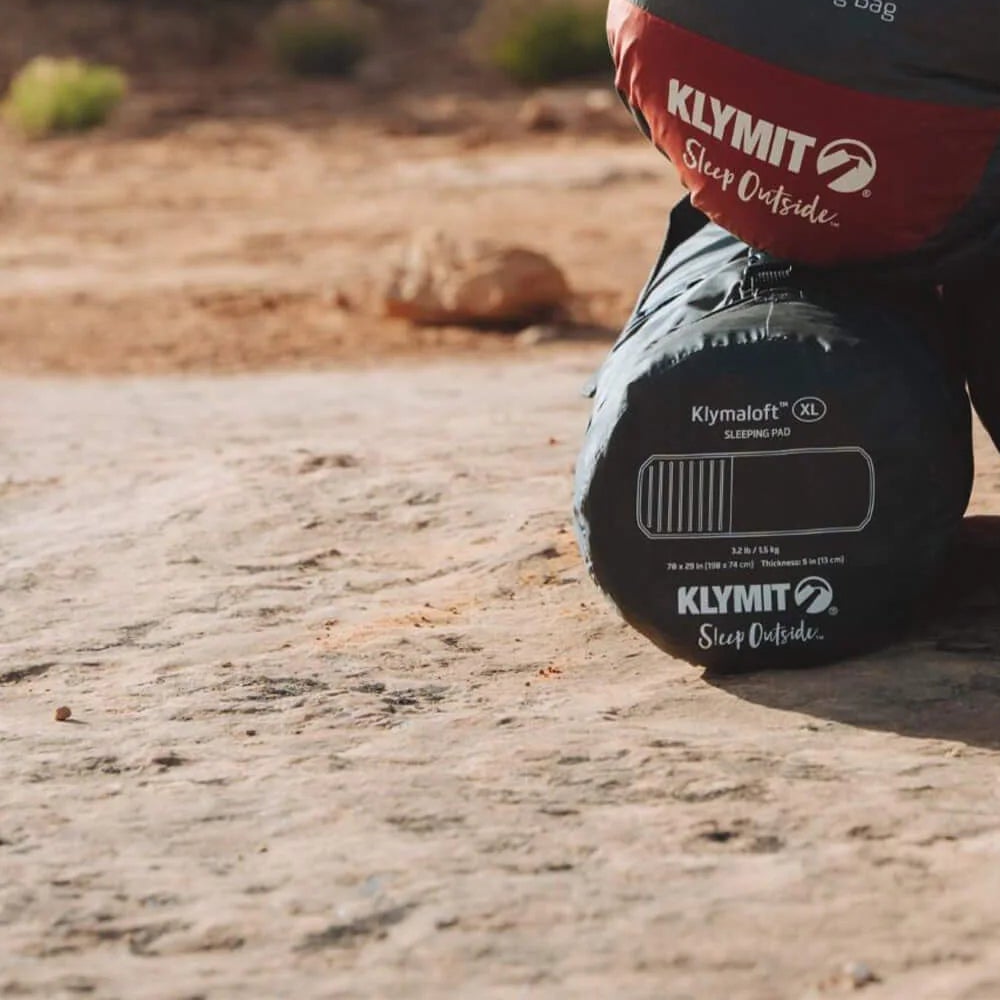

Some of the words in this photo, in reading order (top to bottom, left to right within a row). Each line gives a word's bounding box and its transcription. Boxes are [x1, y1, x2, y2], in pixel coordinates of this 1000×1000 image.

[667, 78, 817, 174] KLYMIT
[682, 138, 734, 191] Sleep
[799, 402, 820, 416] XL
[724, 429, 770, 440] SLEEPING
[771, 427, 791, 438] PAD
[677, 583, 791, 615] KLYMIT
[698, 623, 745, 650] Sleep
